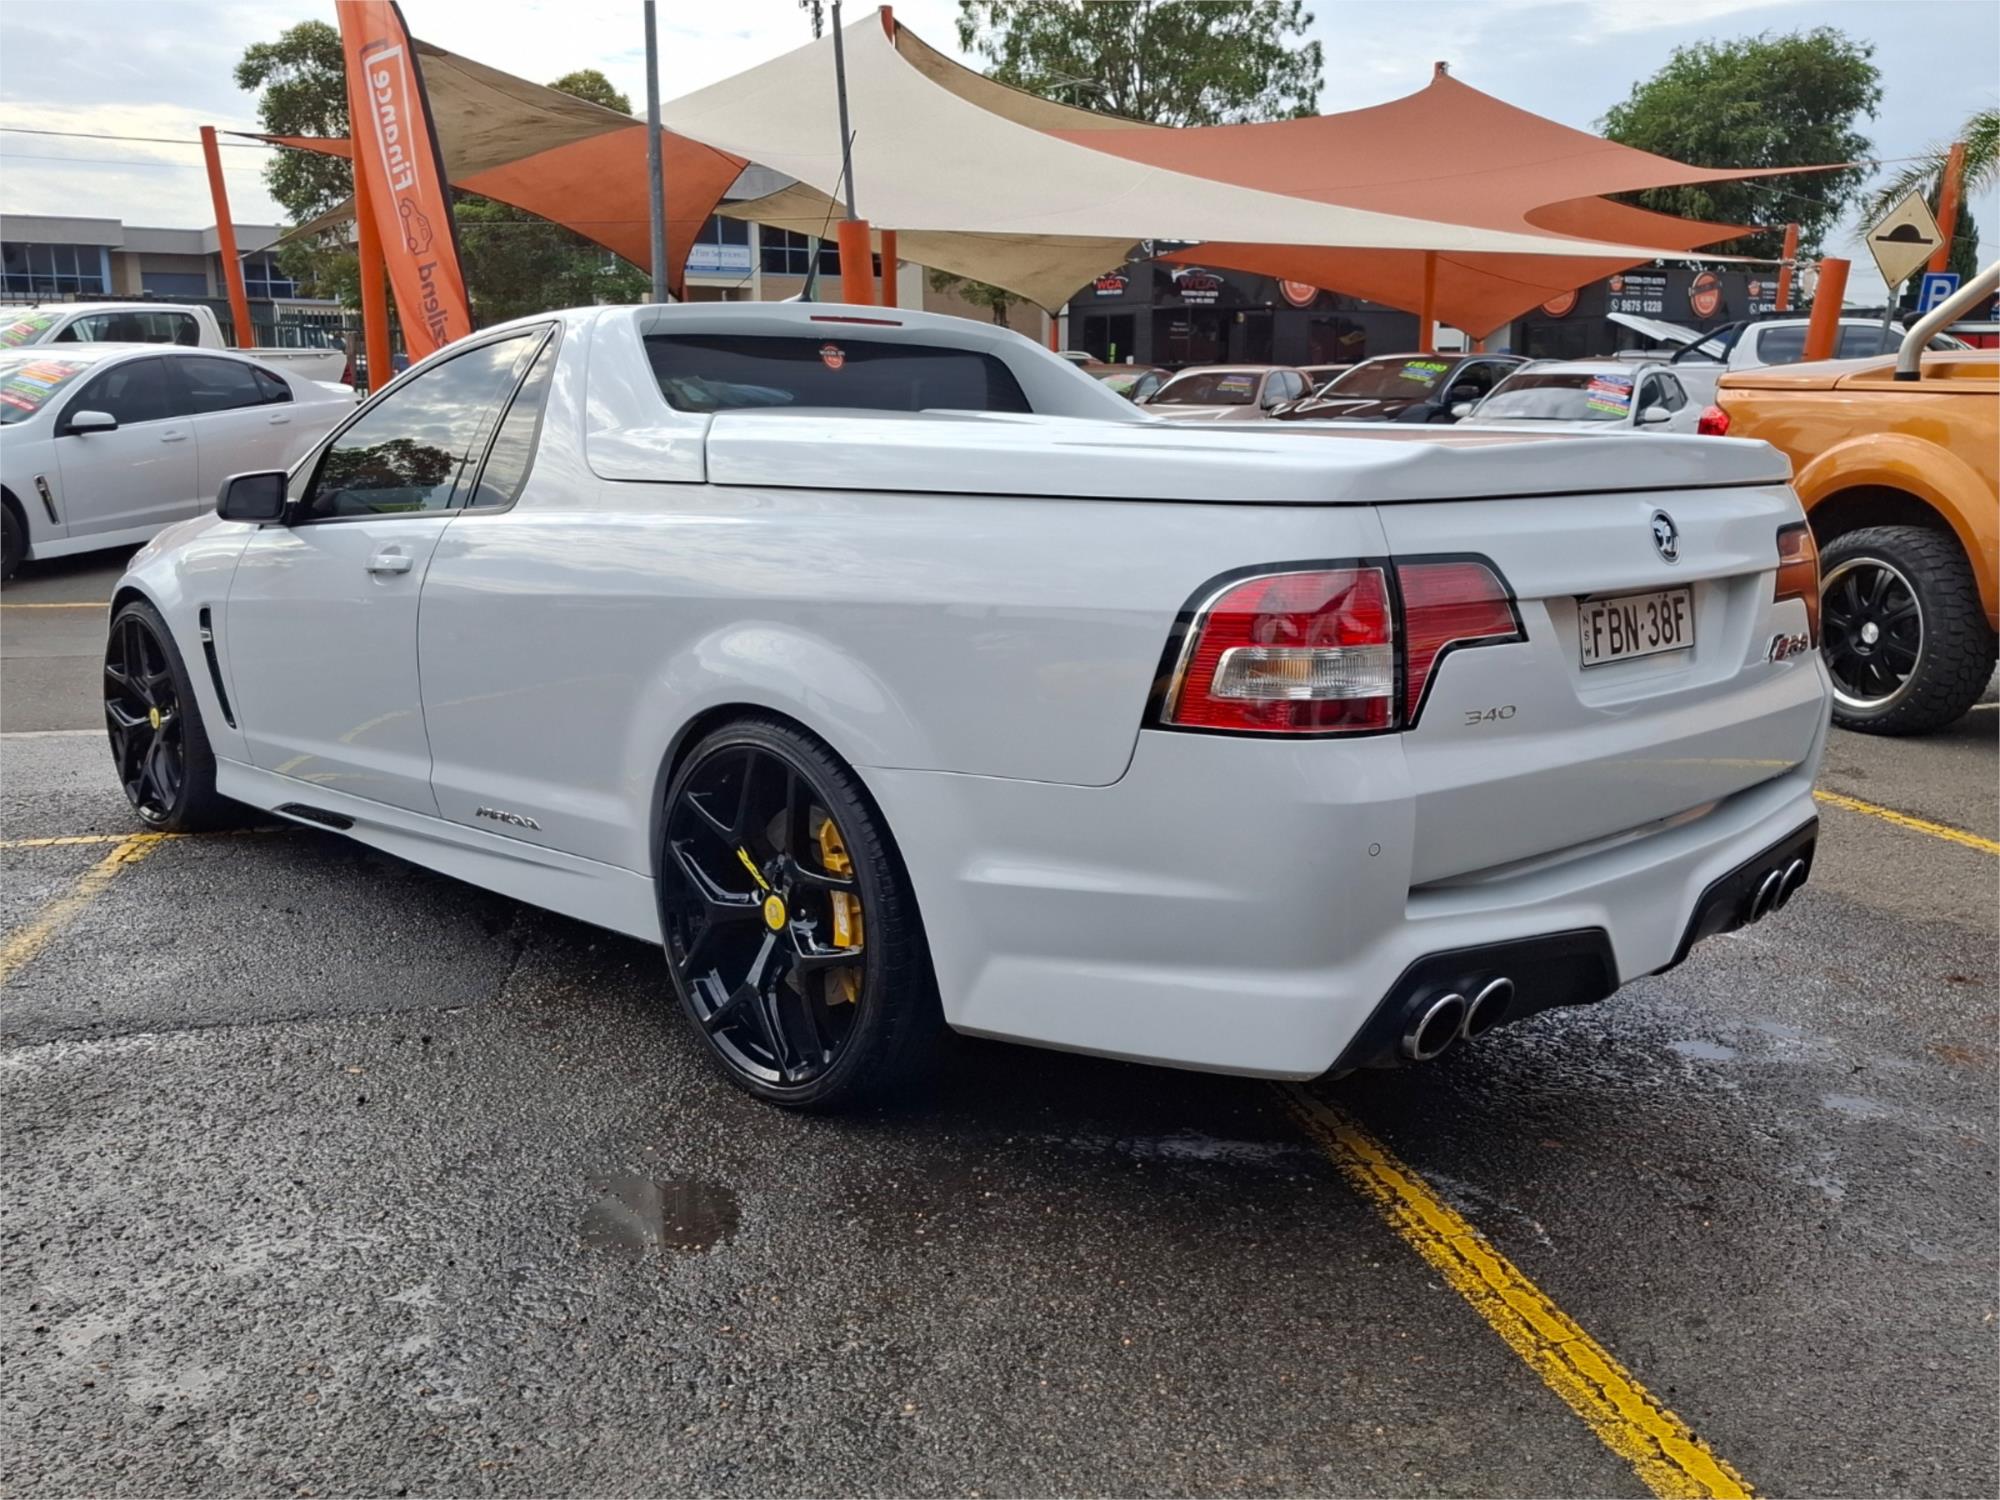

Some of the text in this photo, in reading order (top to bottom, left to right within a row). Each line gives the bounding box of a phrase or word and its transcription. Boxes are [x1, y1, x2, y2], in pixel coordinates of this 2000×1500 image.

[1096, 279, 1123, 289] WCA
[1926, 279, 1951, 313] P
[1464, 704, 1517, 726] 340
